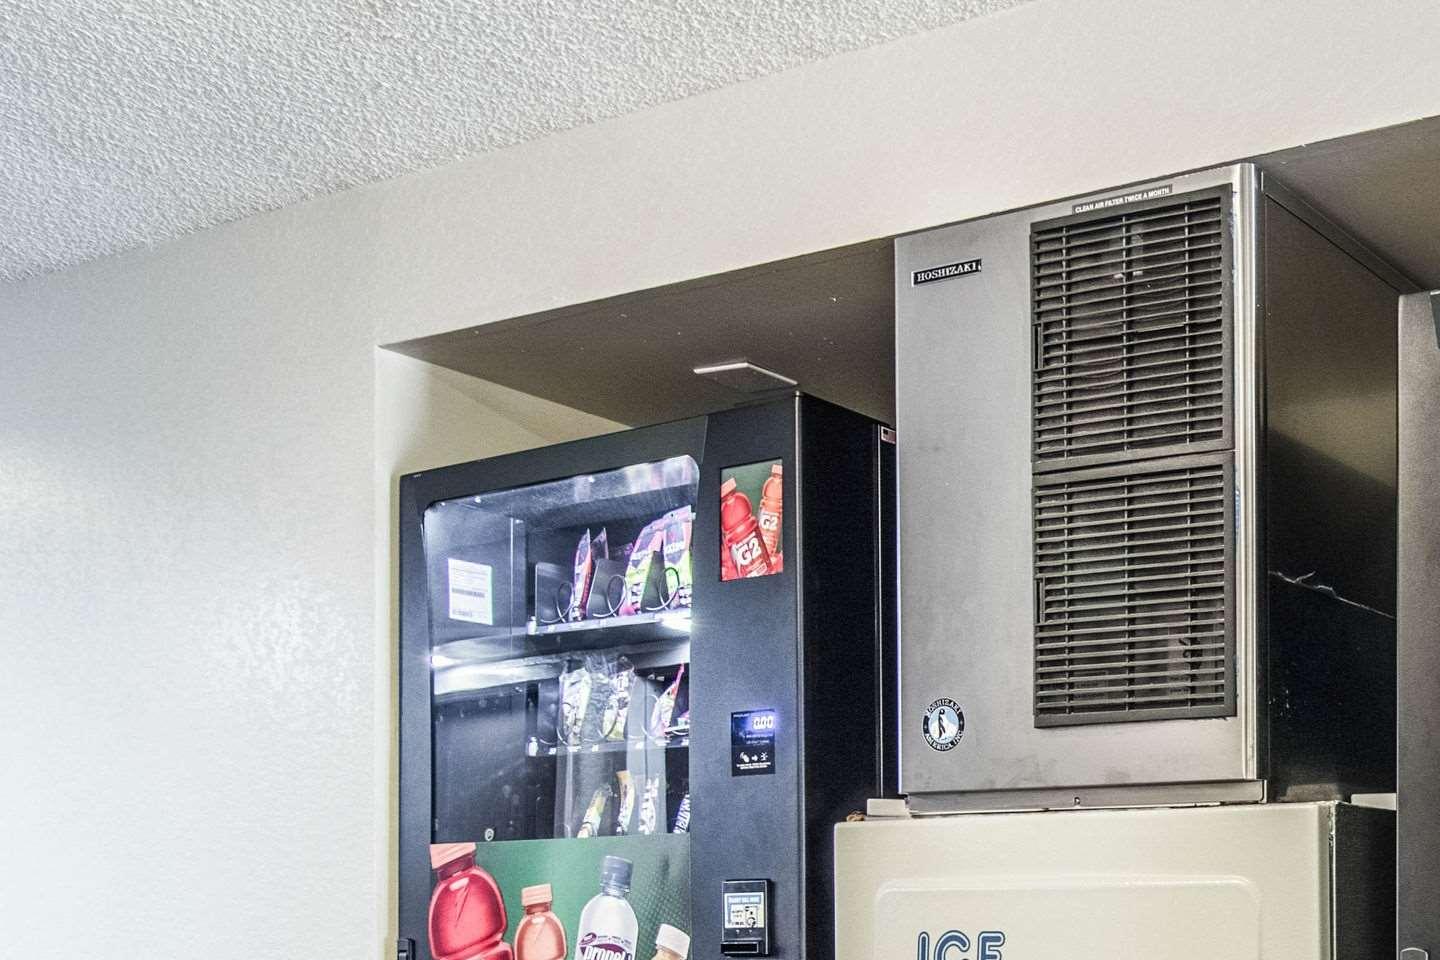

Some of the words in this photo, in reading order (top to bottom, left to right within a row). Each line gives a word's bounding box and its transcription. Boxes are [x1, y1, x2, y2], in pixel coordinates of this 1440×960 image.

[1075, 202, 1094, 213] CLEAN
[1094, 200, 1105, 209] AIR
[1105, 197, 1124, 207] FILTER
[1125, 193, 1142, 204] TWICE
[1143, 191, 1148, 200] A
[1148, 187, 1169, 198] MONTH
[917, 262, 976, 281] HOSHIZAKI
[736, 537, 762, 566] G2
